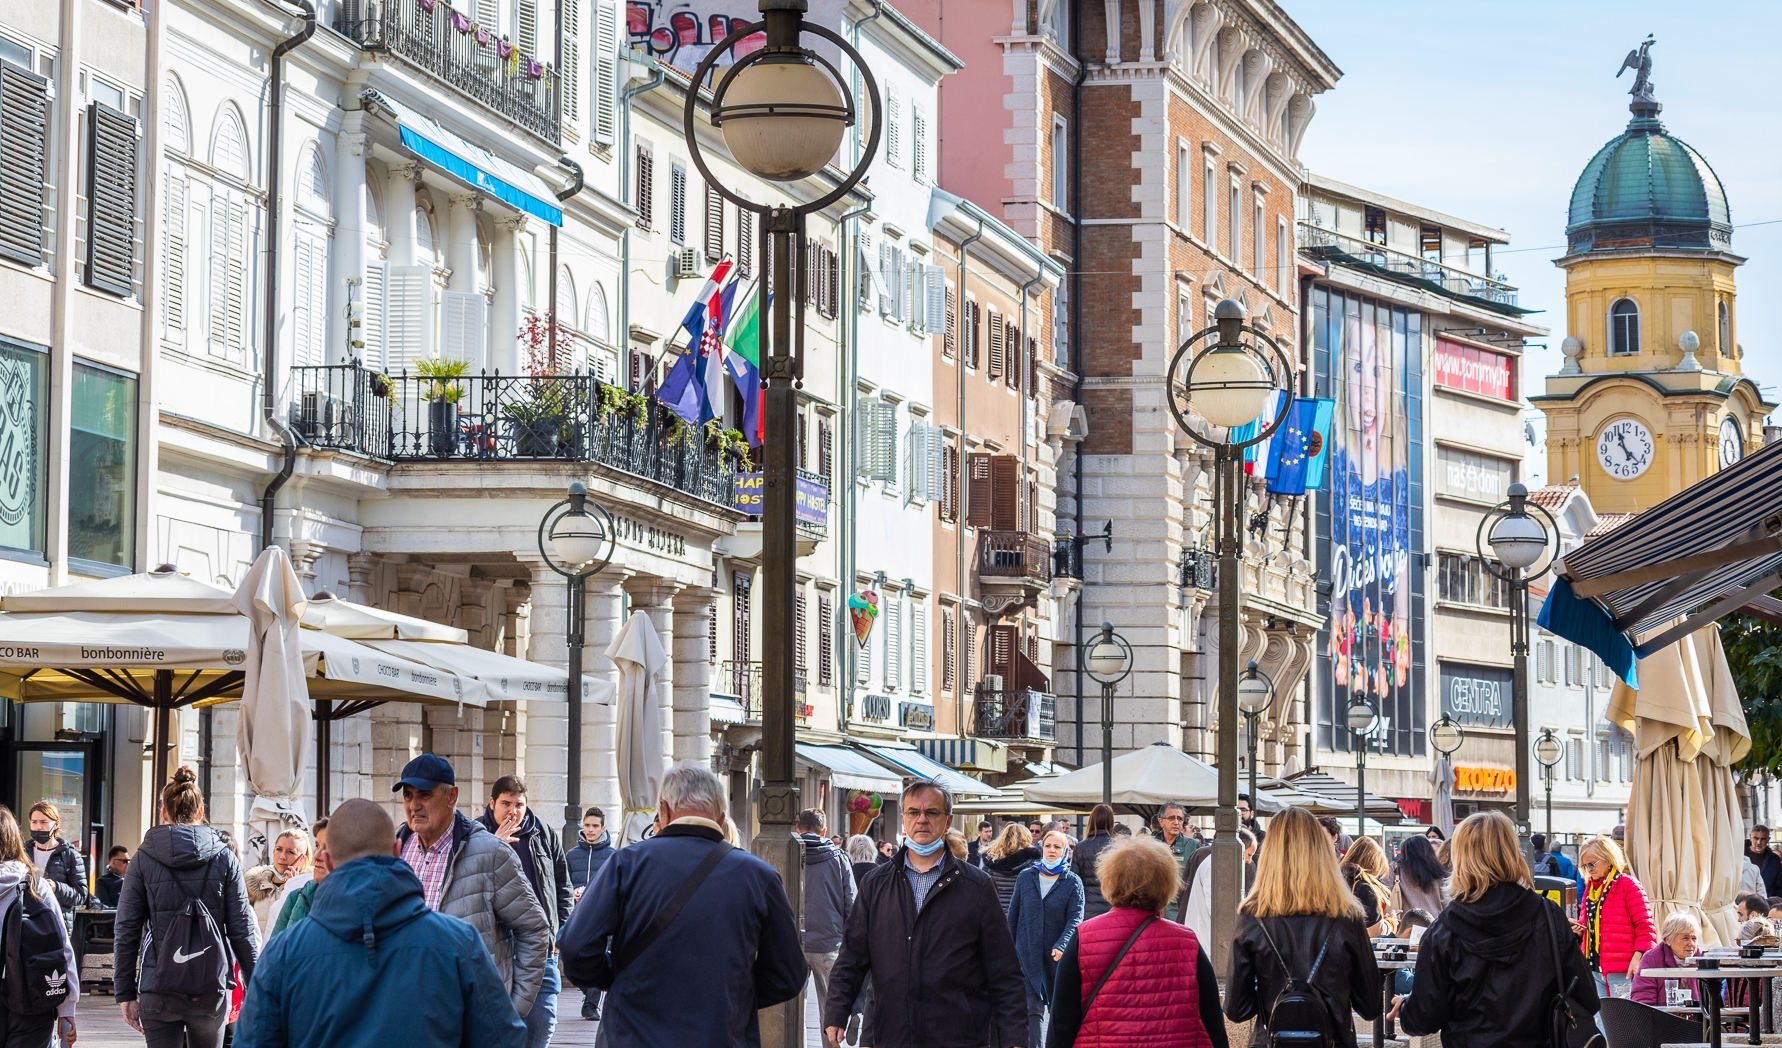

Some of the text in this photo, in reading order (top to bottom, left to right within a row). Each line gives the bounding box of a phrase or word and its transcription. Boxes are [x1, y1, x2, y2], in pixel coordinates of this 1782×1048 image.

[1436, 353, 1510, 389] www.tommy.hr
[1622, 422, 1631, 434] 12
[1604, 431, 1613, 442] 10
[1639, 431, 1646, 442] 2
[1600, 443, 1608, 455] 9
[1644, 442, 1651, 454] 3
[1604, 455, 1612, 467] 8
[1640, 454, 1646, 465] 4
[1614, 463, 1621, 474] 7
[1621, 465, 1630, 477] 6
[1631, 463, 1639, 474] 5
[1478, 464, 1501, 496] dom
[17, 648, 39, 659] BAR
[81, 646, 165, 661] bonbonnière
[378, 664, 392, 677] CHOCO
[411, 670, 437, 687] bonbonnière
[1450, 676, 1502, 716] CENTRA
[867, 695, 891, 720] CORSO
[1455, 766, 1517, 792] KORZO
[46, 988, 66, 996] adidas
